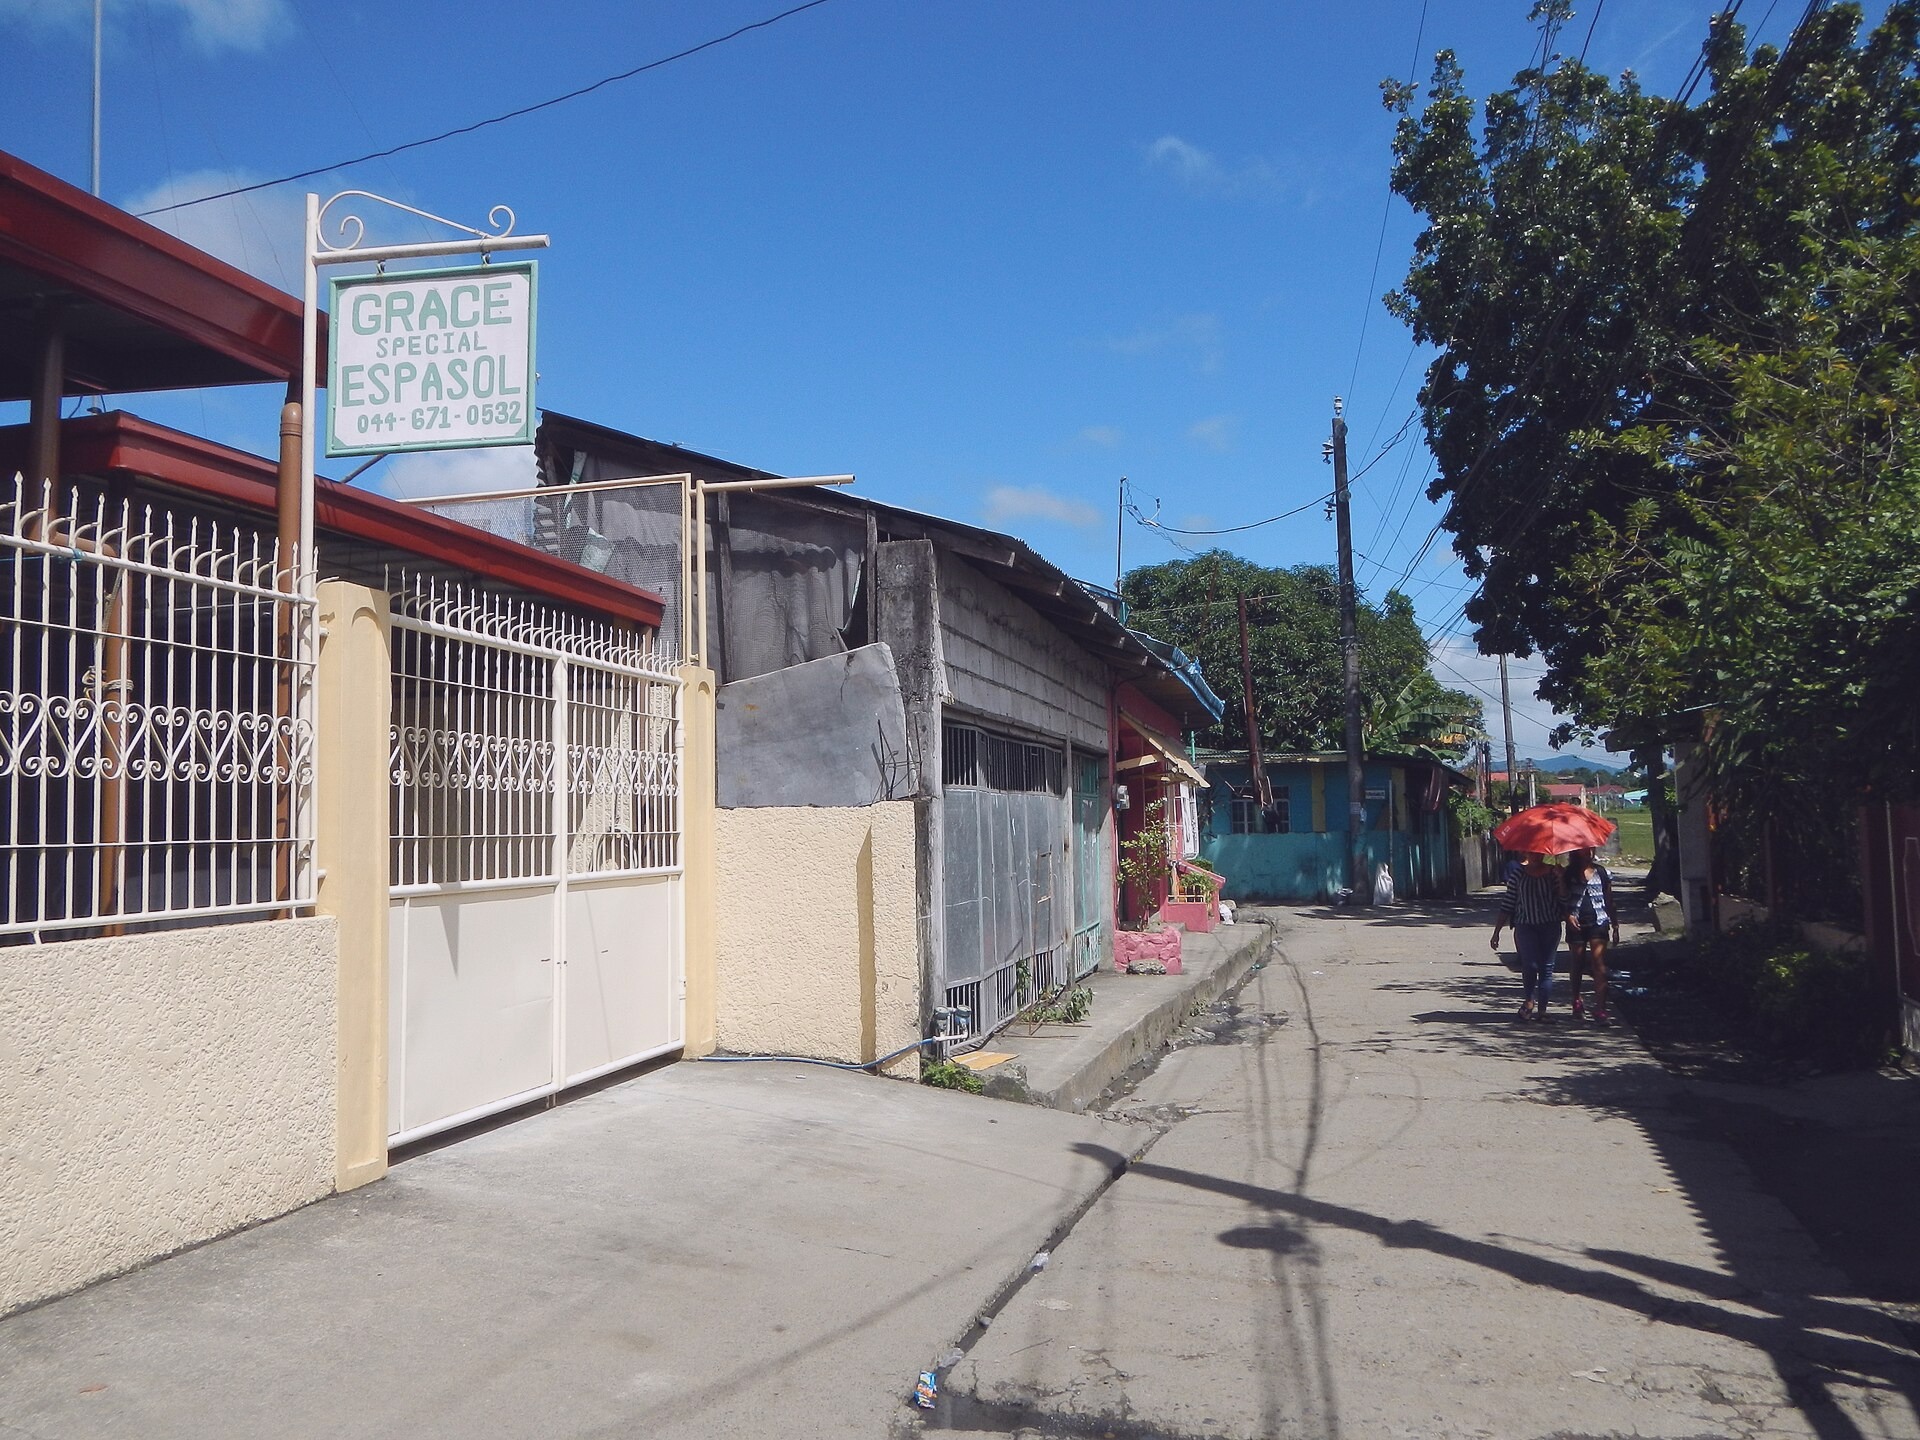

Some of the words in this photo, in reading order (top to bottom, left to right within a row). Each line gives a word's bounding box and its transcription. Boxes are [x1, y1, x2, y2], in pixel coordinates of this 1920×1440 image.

[352, 282, 512, 335] GRACE
[376, 331, 487, 358] SPECIAL
[341, 355, 520, 407] ESPASOL
